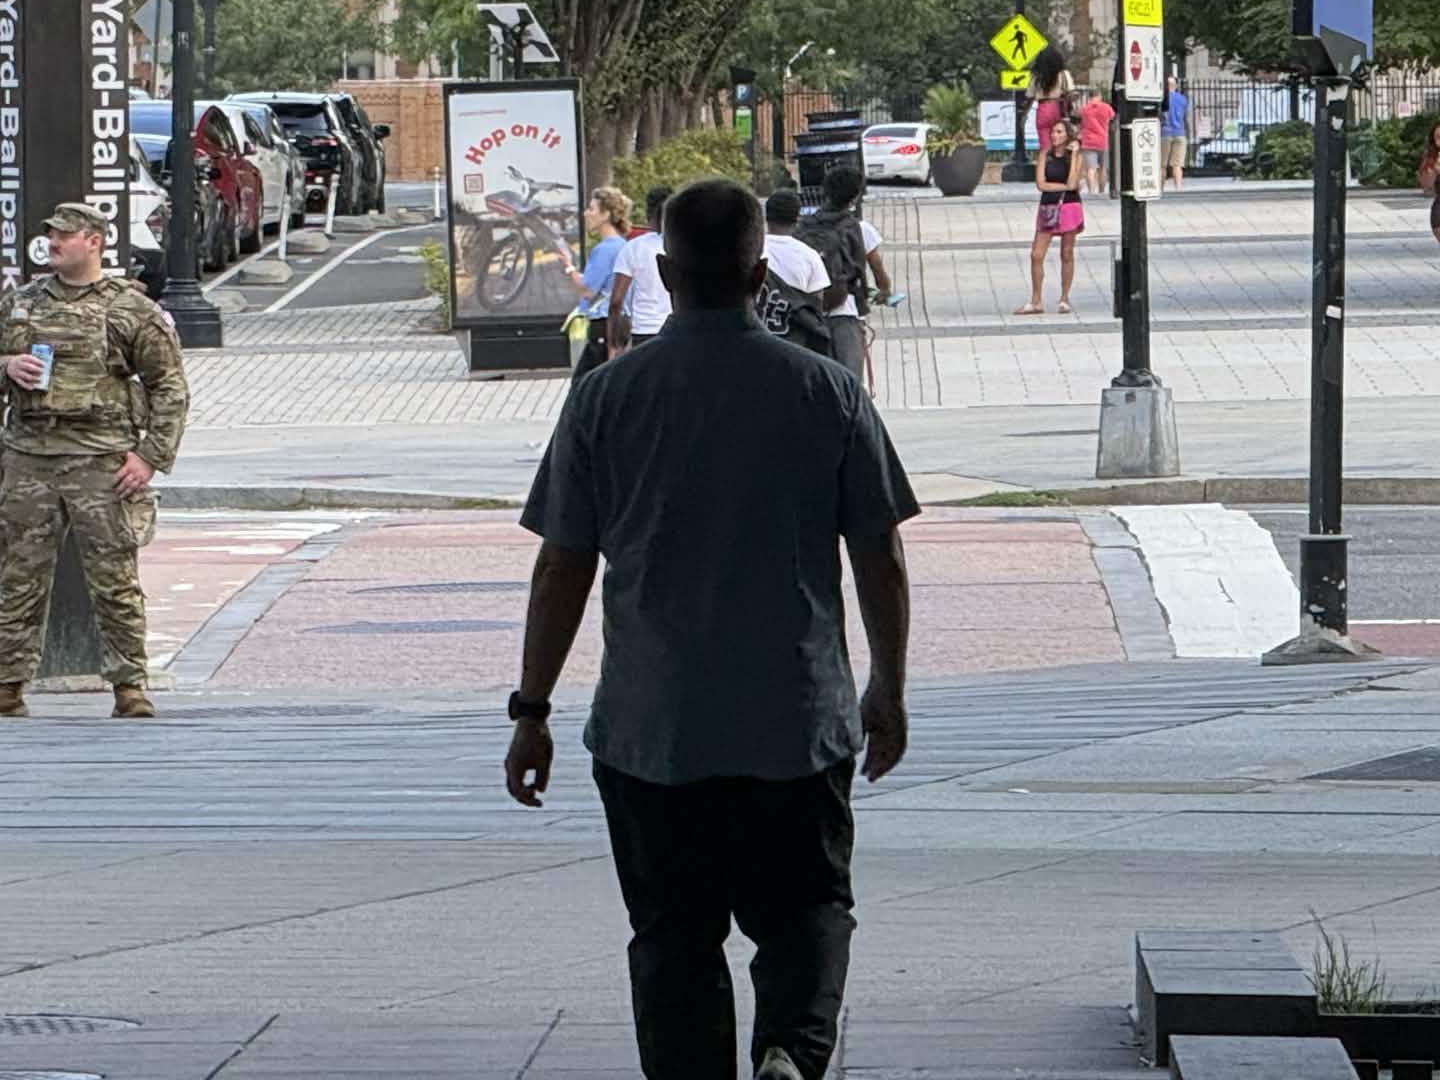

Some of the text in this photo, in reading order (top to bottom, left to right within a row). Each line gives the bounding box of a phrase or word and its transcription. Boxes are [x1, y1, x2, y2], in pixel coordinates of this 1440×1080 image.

[465, 124, 561, 165] Hop on it
